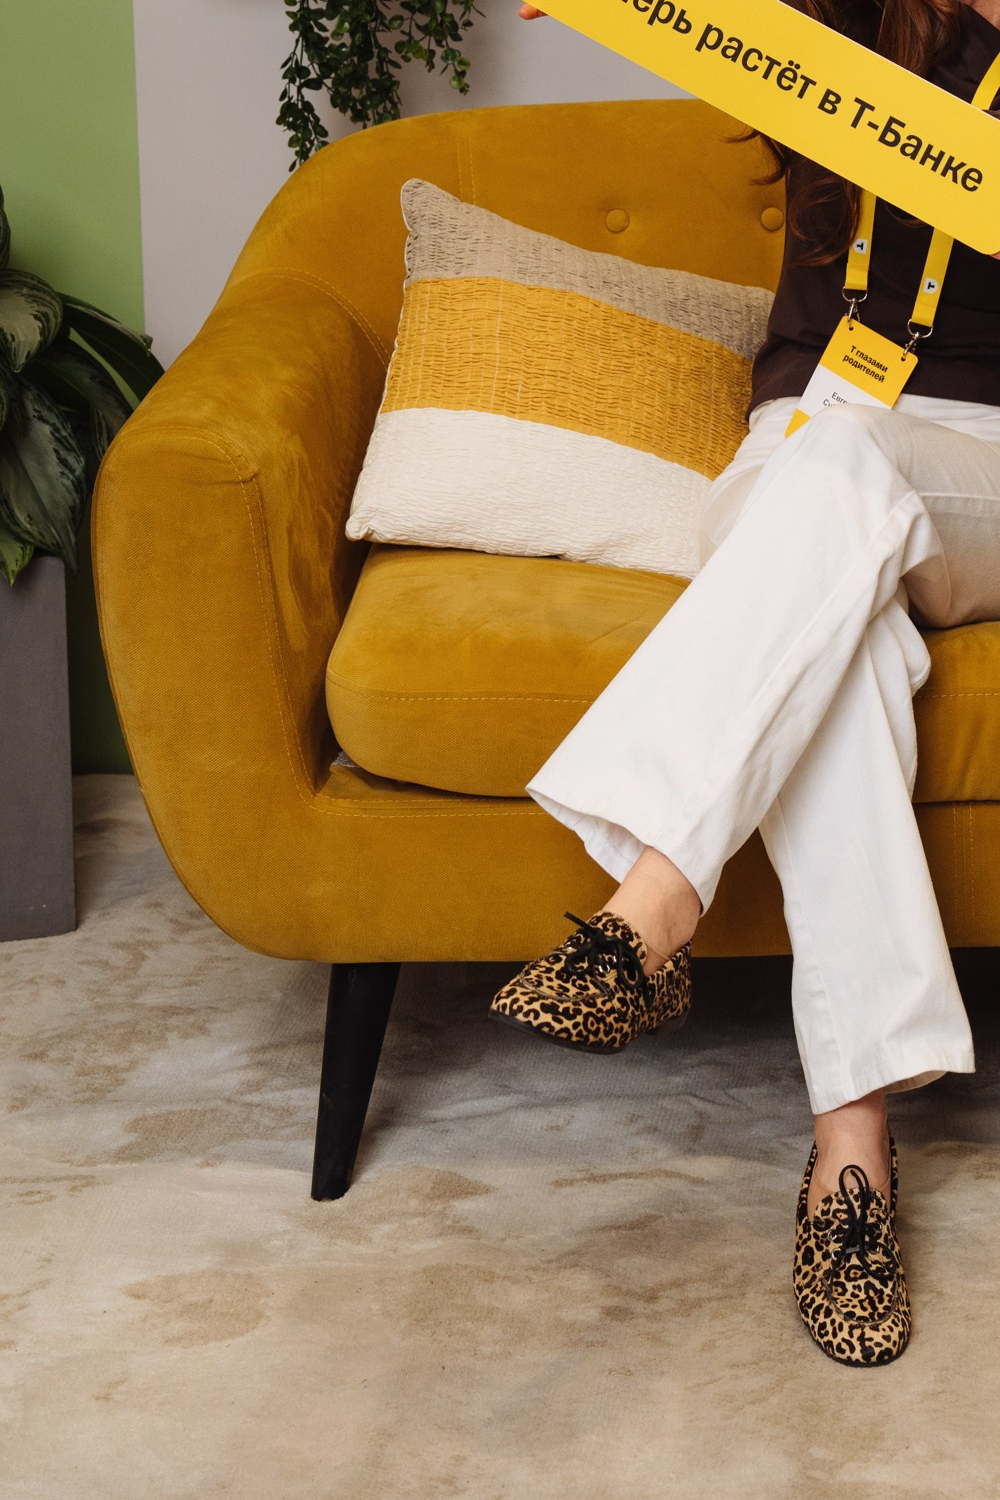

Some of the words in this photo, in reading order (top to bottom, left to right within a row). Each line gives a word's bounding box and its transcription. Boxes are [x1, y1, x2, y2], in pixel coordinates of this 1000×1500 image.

[694, 23, 817, 100] растёт
[817, 88, 842, 115] в
[850, 96, 984, 193] Т-Банке
[842, 354, 885, 383] родителей
[850, 345, 857, 353] Т
[855, 350, 889, 373] глазами
